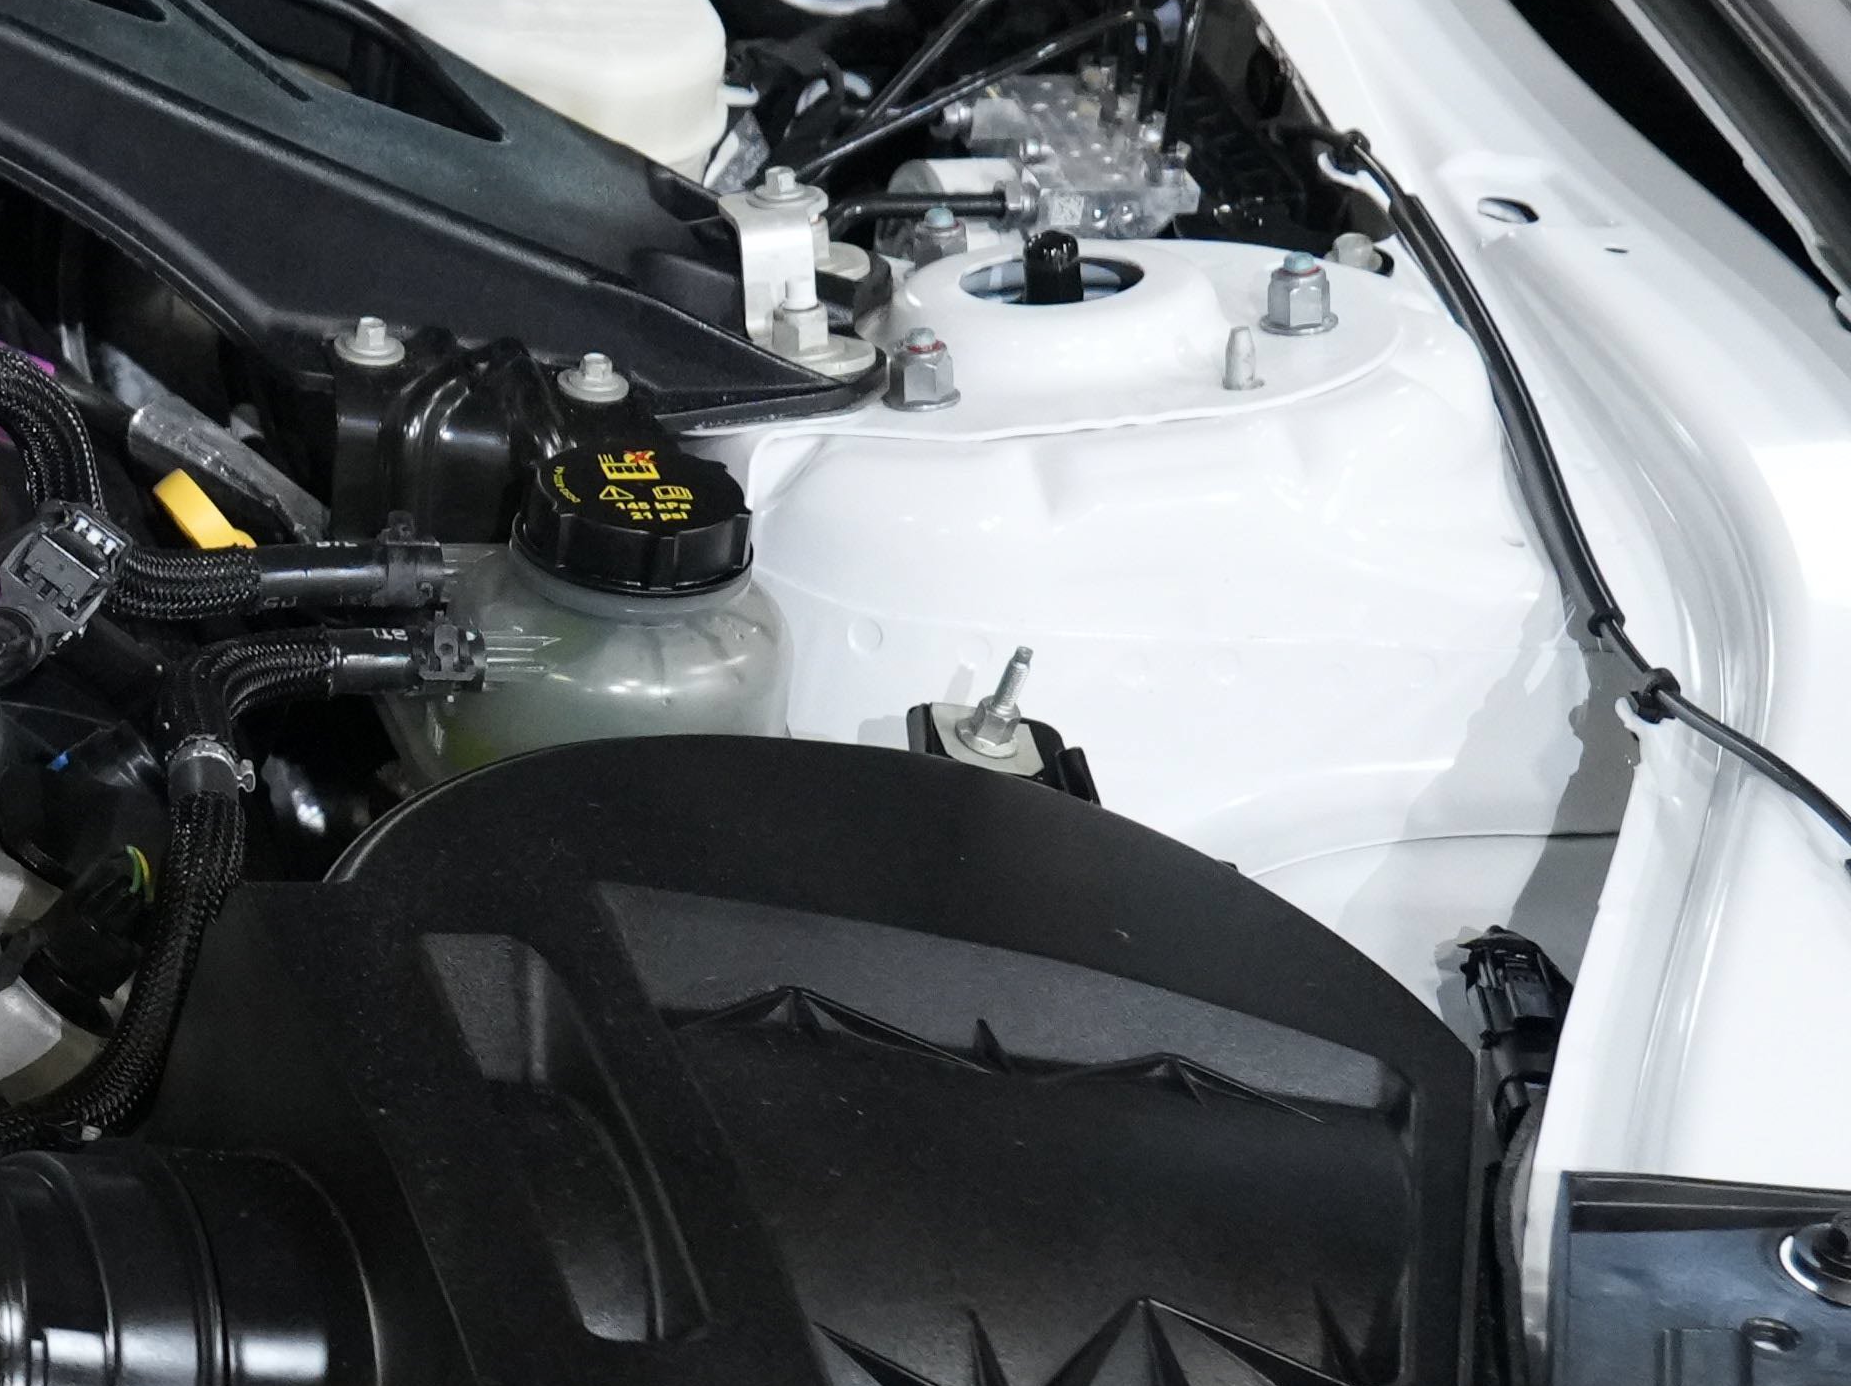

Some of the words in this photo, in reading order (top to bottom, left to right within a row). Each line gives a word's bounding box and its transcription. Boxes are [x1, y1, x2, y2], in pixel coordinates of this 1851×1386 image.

[615, 501, 651, 511] 145
[653, 500, 692, 511] kPa
[630, 511, 654, 521] 21
[659, 511, 688, 522] psi
